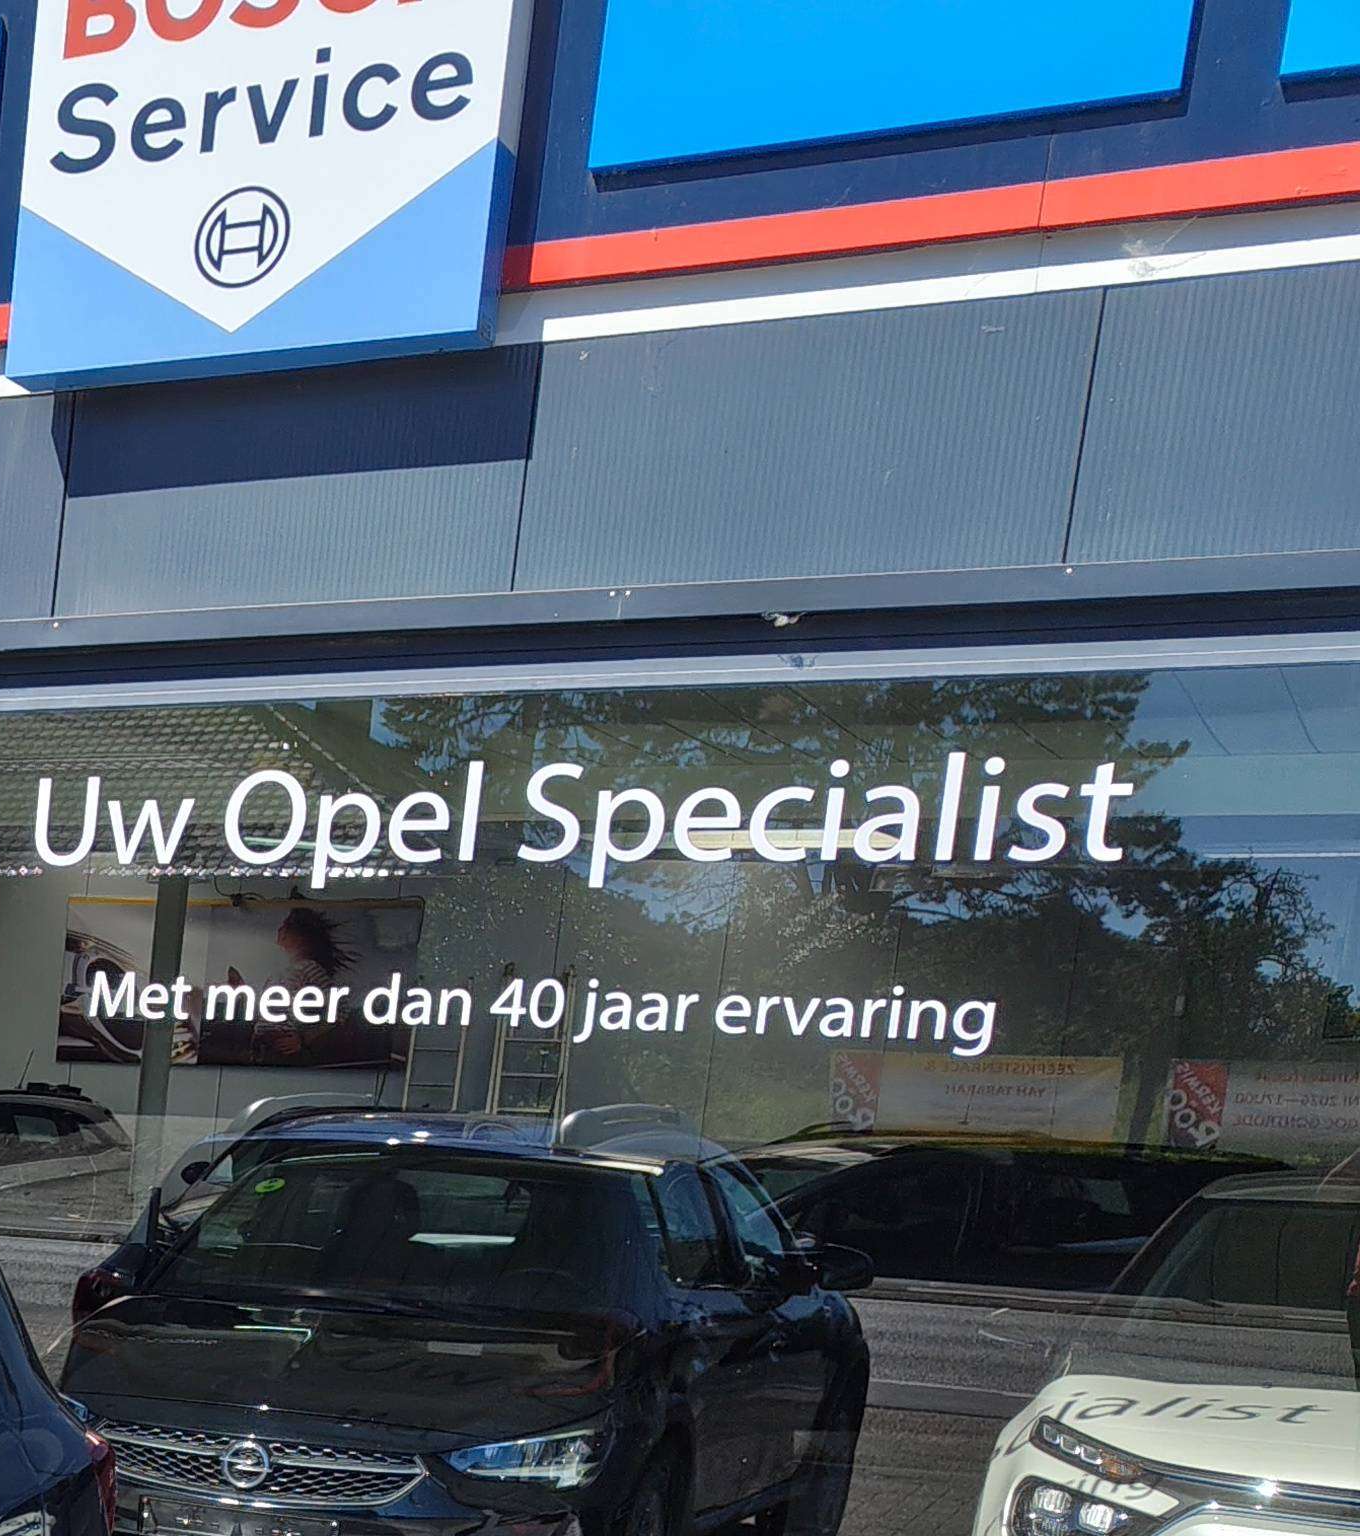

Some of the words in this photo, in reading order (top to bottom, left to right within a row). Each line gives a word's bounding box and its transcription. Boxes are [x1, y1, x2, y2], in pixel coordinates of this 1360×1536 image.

[50, 47, 473, 174] Service
[35, 776, 195, 867] Uw
[224, 760, 484, 889] Opel
[517, 752, 1133, 888] Specialist
[89, 971, 191, 1022] Met
[205, 982, 349, 1023] meer
[363, 973, 472, 1026] dan
[490, 978, 565, 1029] 40
[573, 979, 700, 1044] jaar
[714, 985, 997, 1057] ervaring
